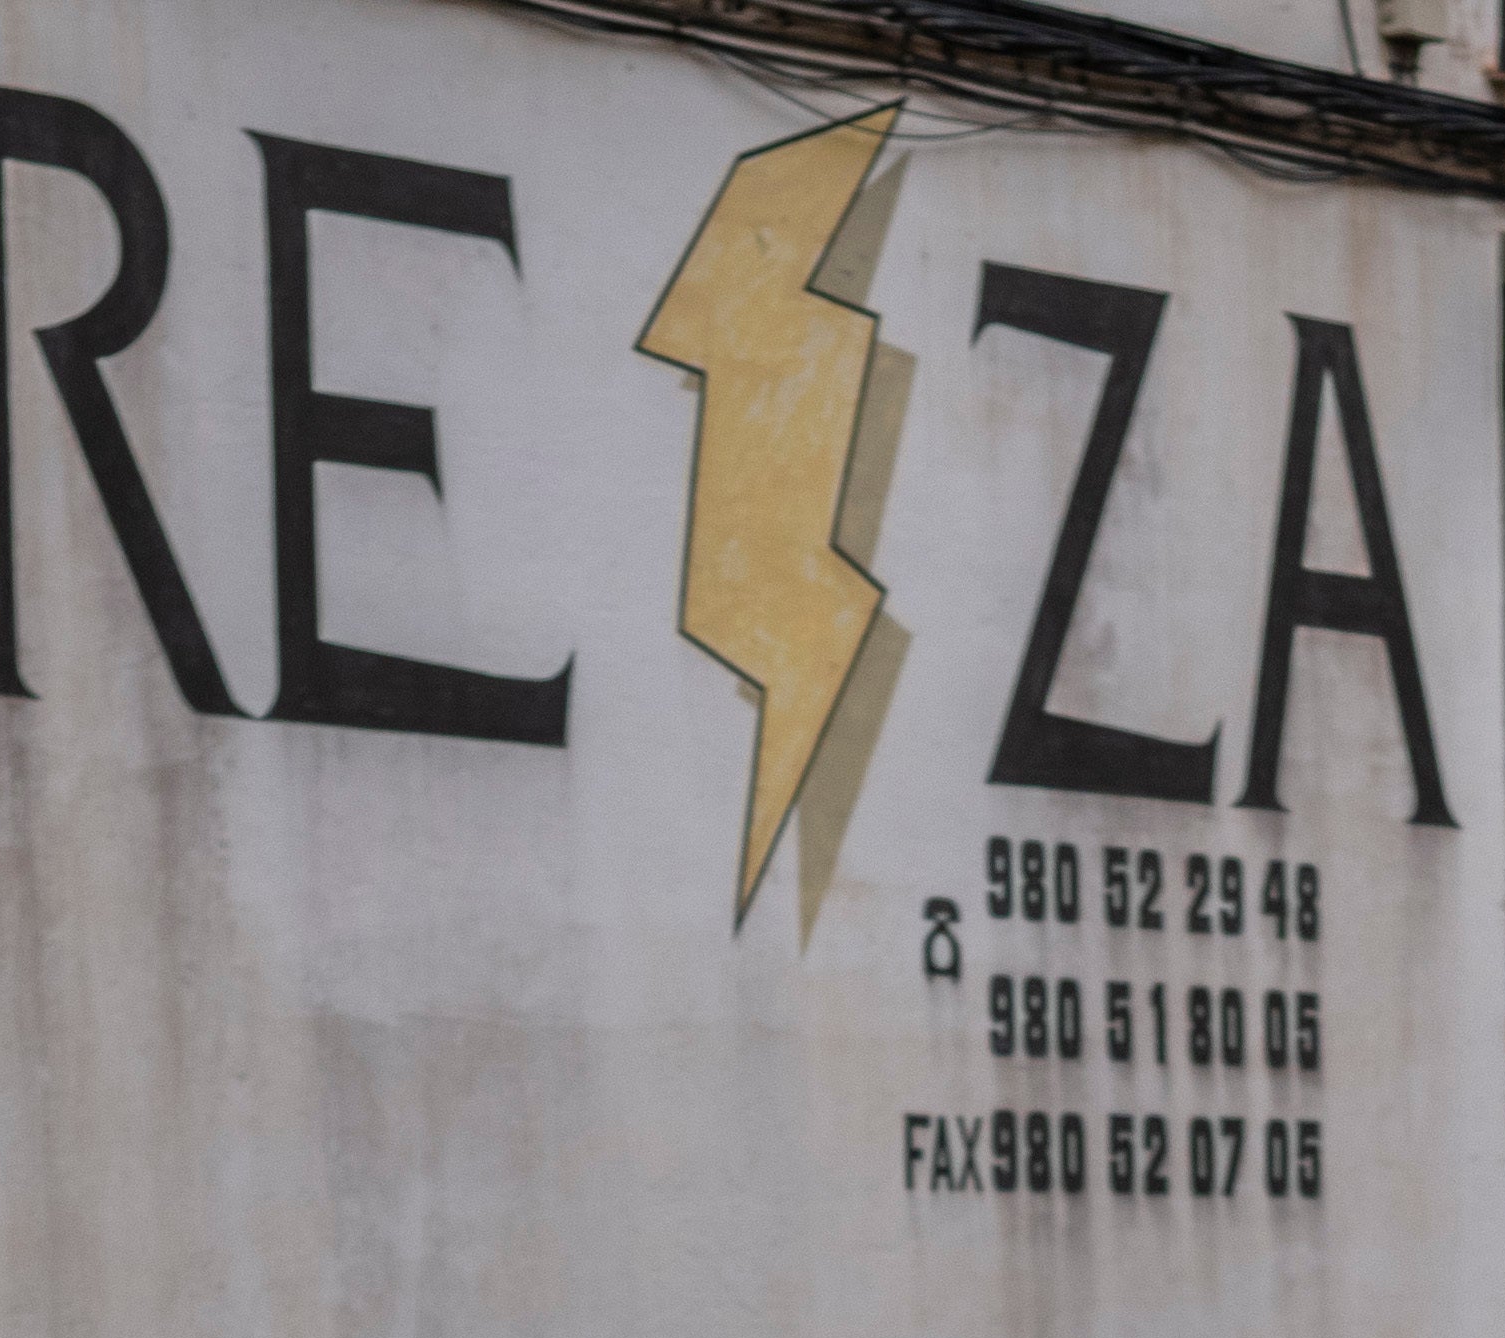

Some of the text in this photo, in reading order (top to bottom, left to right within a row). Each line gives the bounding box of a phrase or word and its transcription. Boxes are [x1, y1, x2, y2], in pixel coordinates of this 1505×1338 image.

[986, 835, 1321, 942] 980 52 29 48
[988, 975, 1322, 1072] 980 51 80 05
[904, 1110, 1323, 1200] FAX 980 52 07 05
